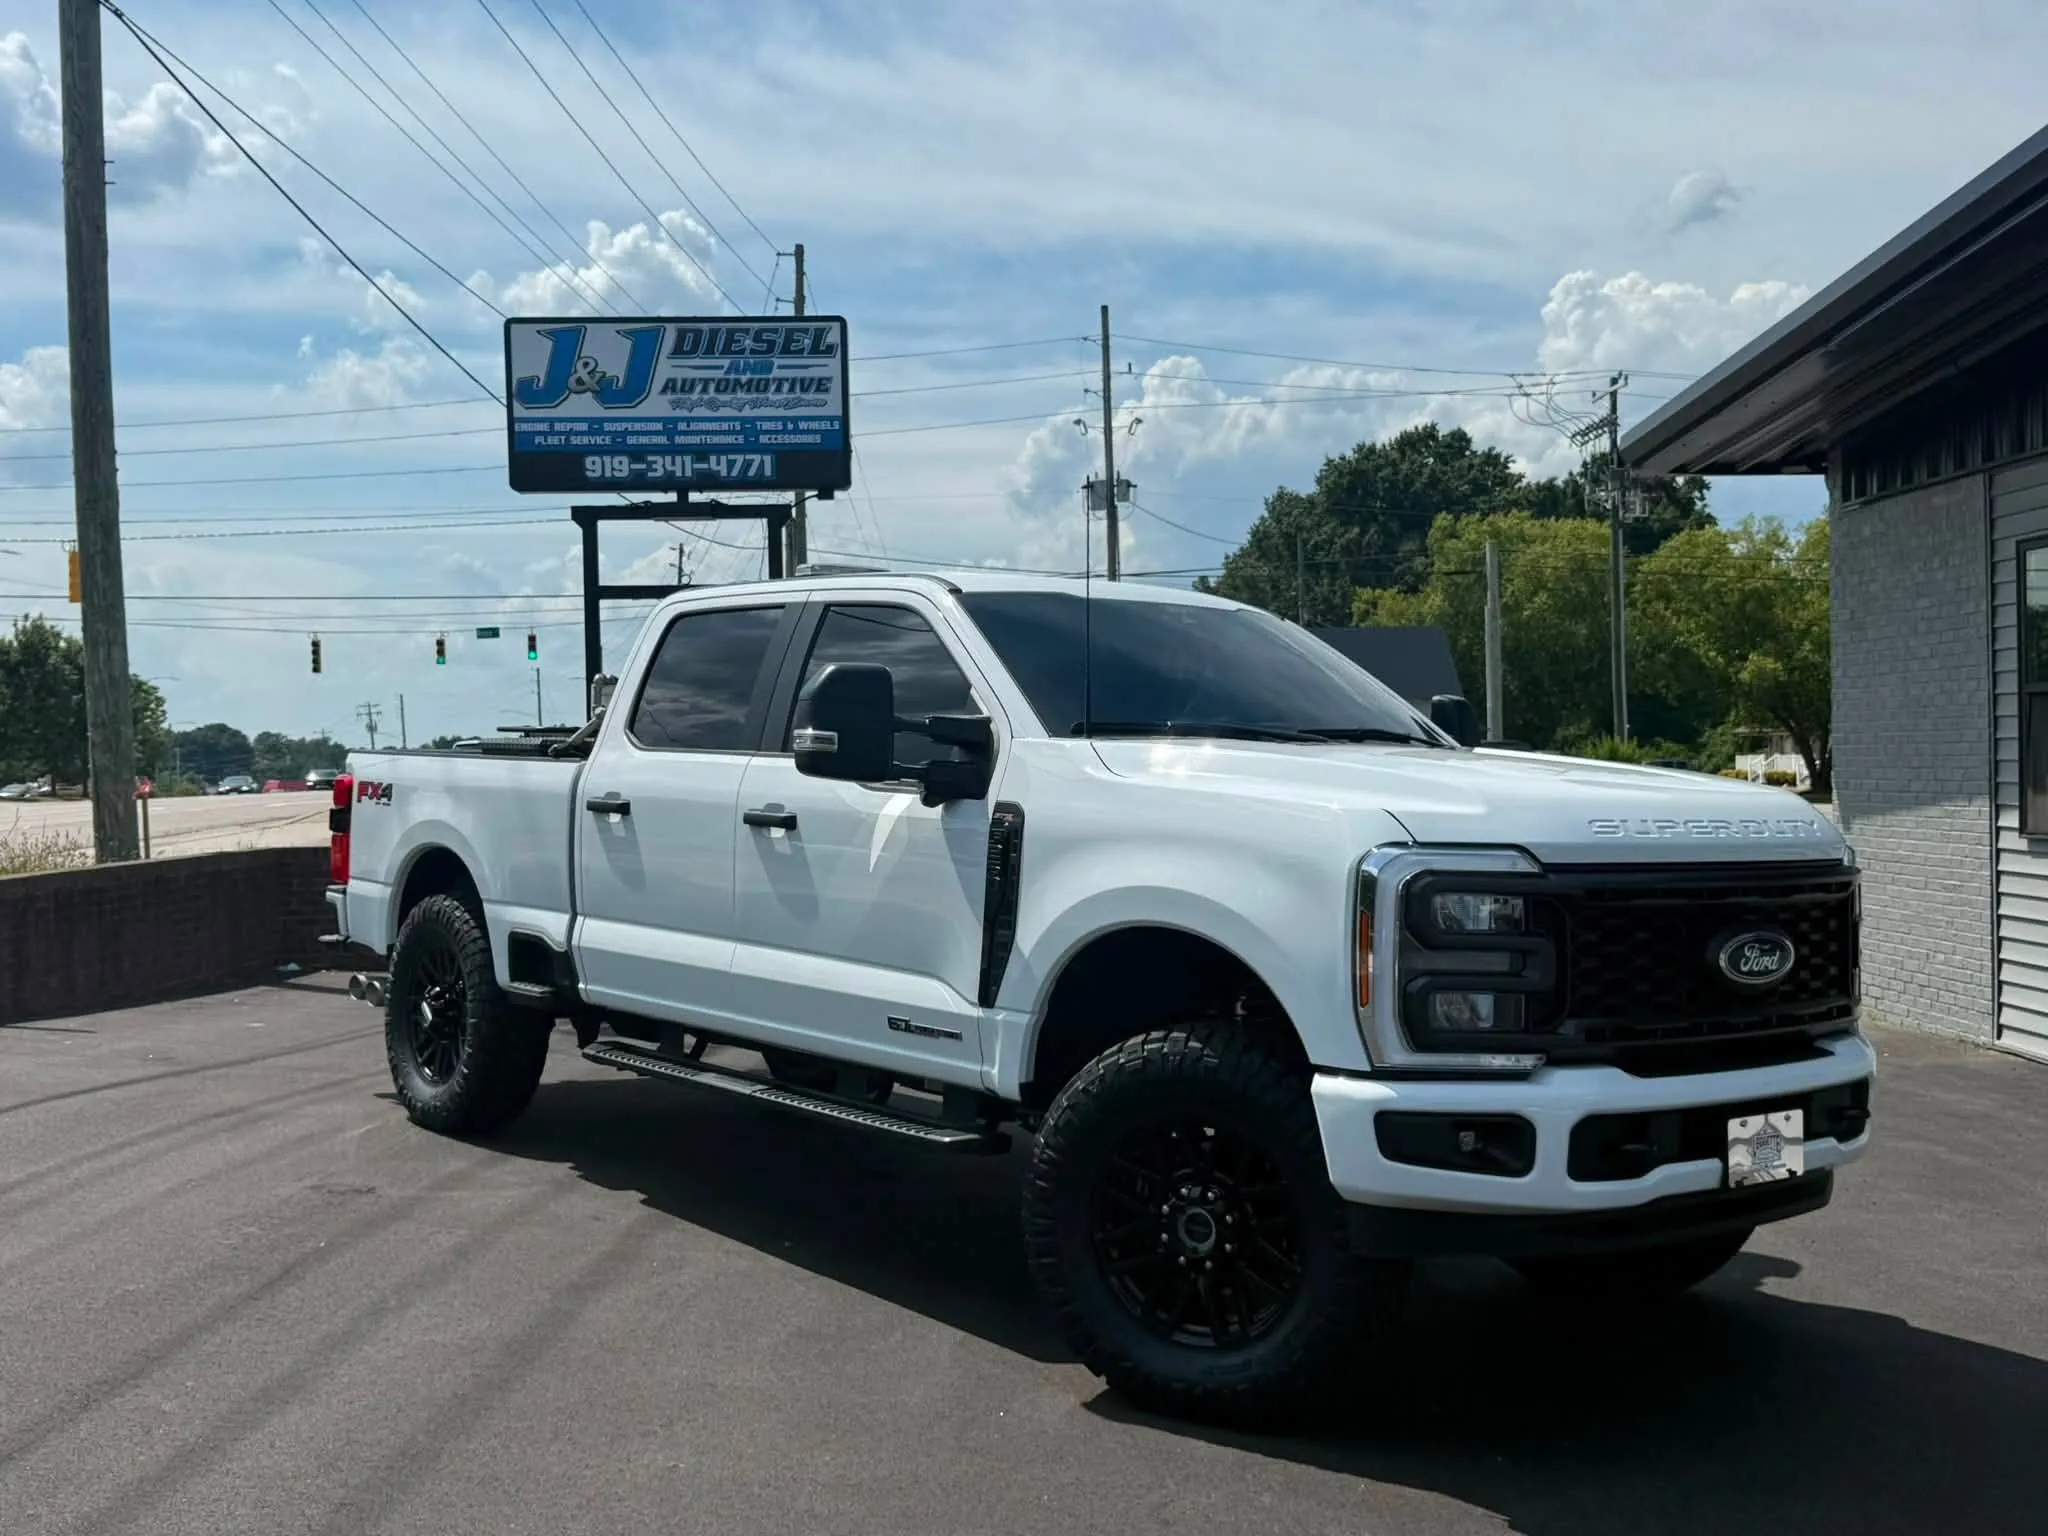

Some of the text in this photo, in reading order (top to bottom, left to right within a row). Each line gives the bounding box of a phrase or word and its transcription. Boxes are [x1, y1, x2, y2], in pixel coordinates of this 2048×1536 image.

[667, 326, 839, 358] DIESEL
[514, 325, 666, 410] J&J
[723, 359, 775, 376] AND
[658, 376, 833, 395] AUTOMOTIVE
[554, 422, 589, 432] REPAIR
[603, 422, 663, 432] SUSPENSION
[755, 421, 784, 431] TIRES
[798, 420, 840, 430] WHEELS
[534, 435, 566, 445] FLEET
[569, 435, 612, 445] SERVICE
[626, 435, 671, 445] GENERAL
[584, 454, 773, 478] 919-341-4771
[357, 781, 393, 803] FX4
[1740, 943, 1780, 972] Ford
